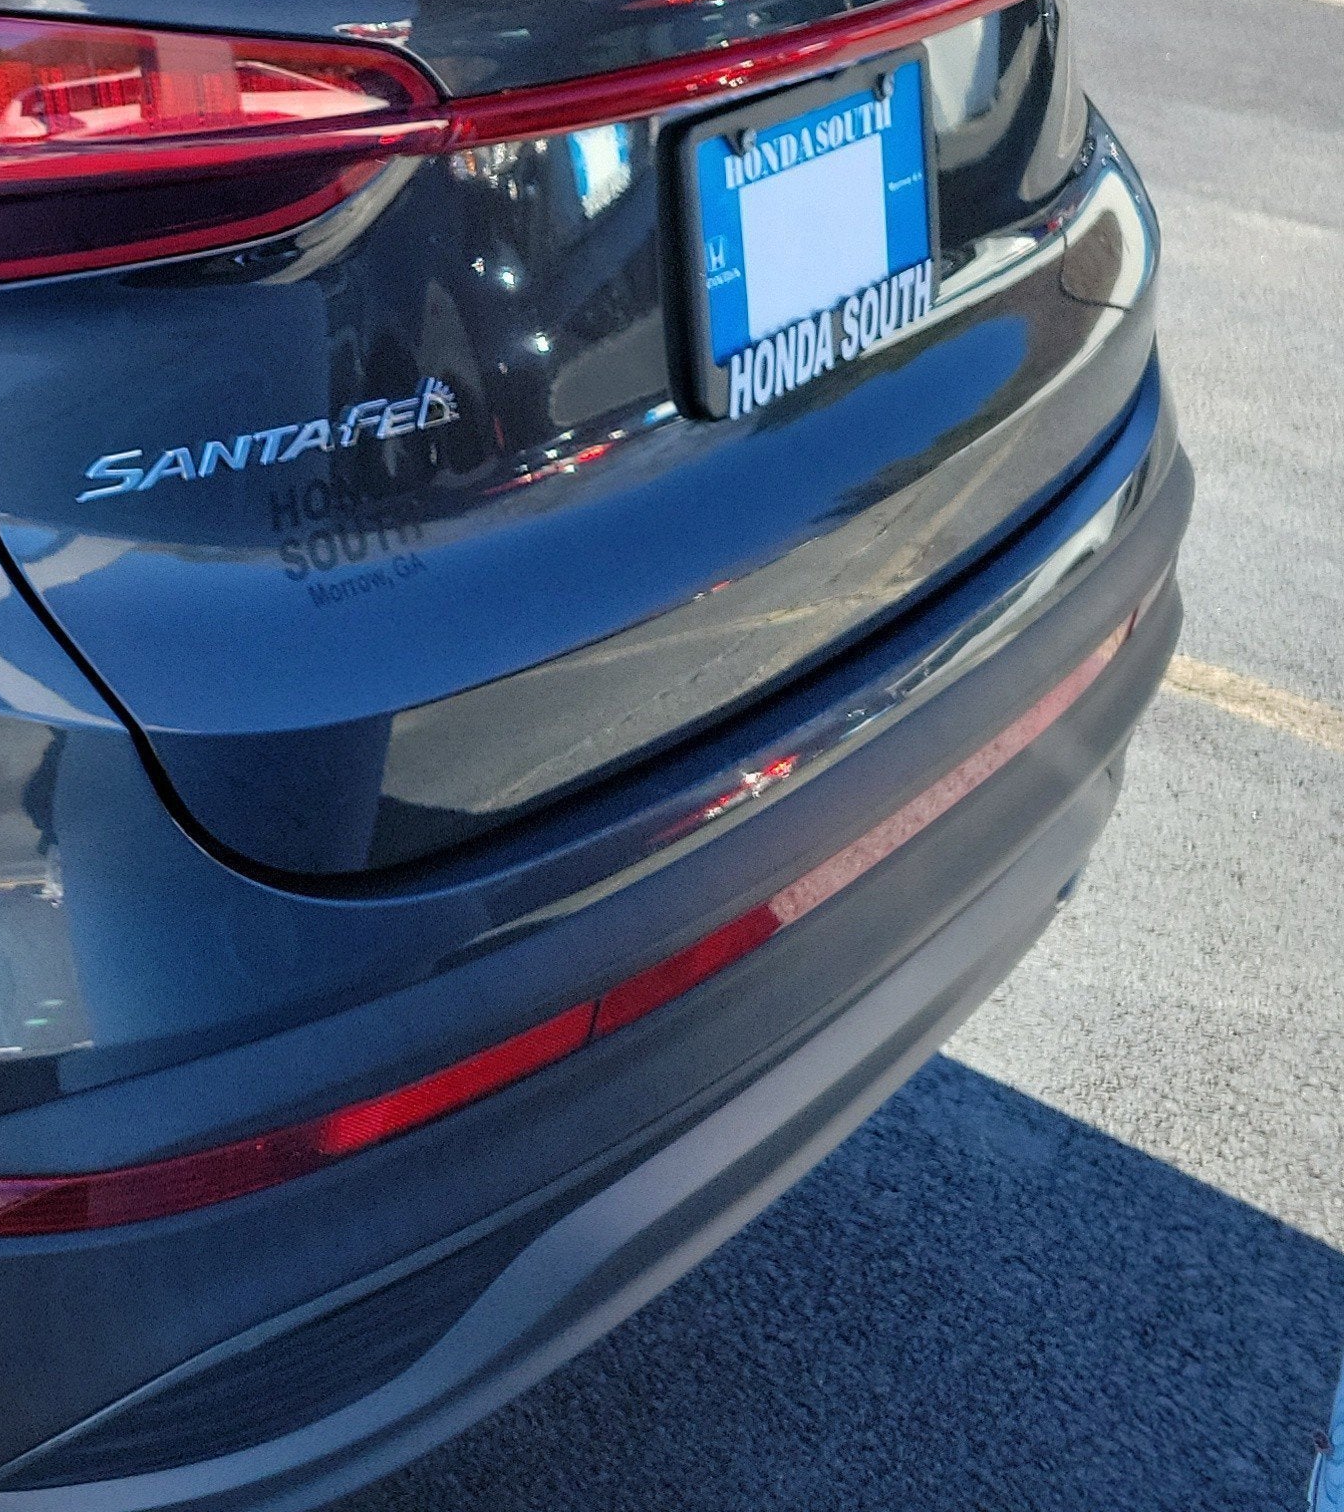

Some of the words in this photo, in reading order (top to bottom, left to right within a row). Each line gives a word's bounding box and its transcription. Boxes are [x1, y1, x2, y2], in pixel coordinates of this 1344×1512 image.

[723, 126, 815, 189] HONDA
[815, 97, 892, 155] SOUTH
[729, 309, 835, 421] HONDA
[840, 258, 932, 362] SOUTH
[74, 417, 335, 504] SANTA
